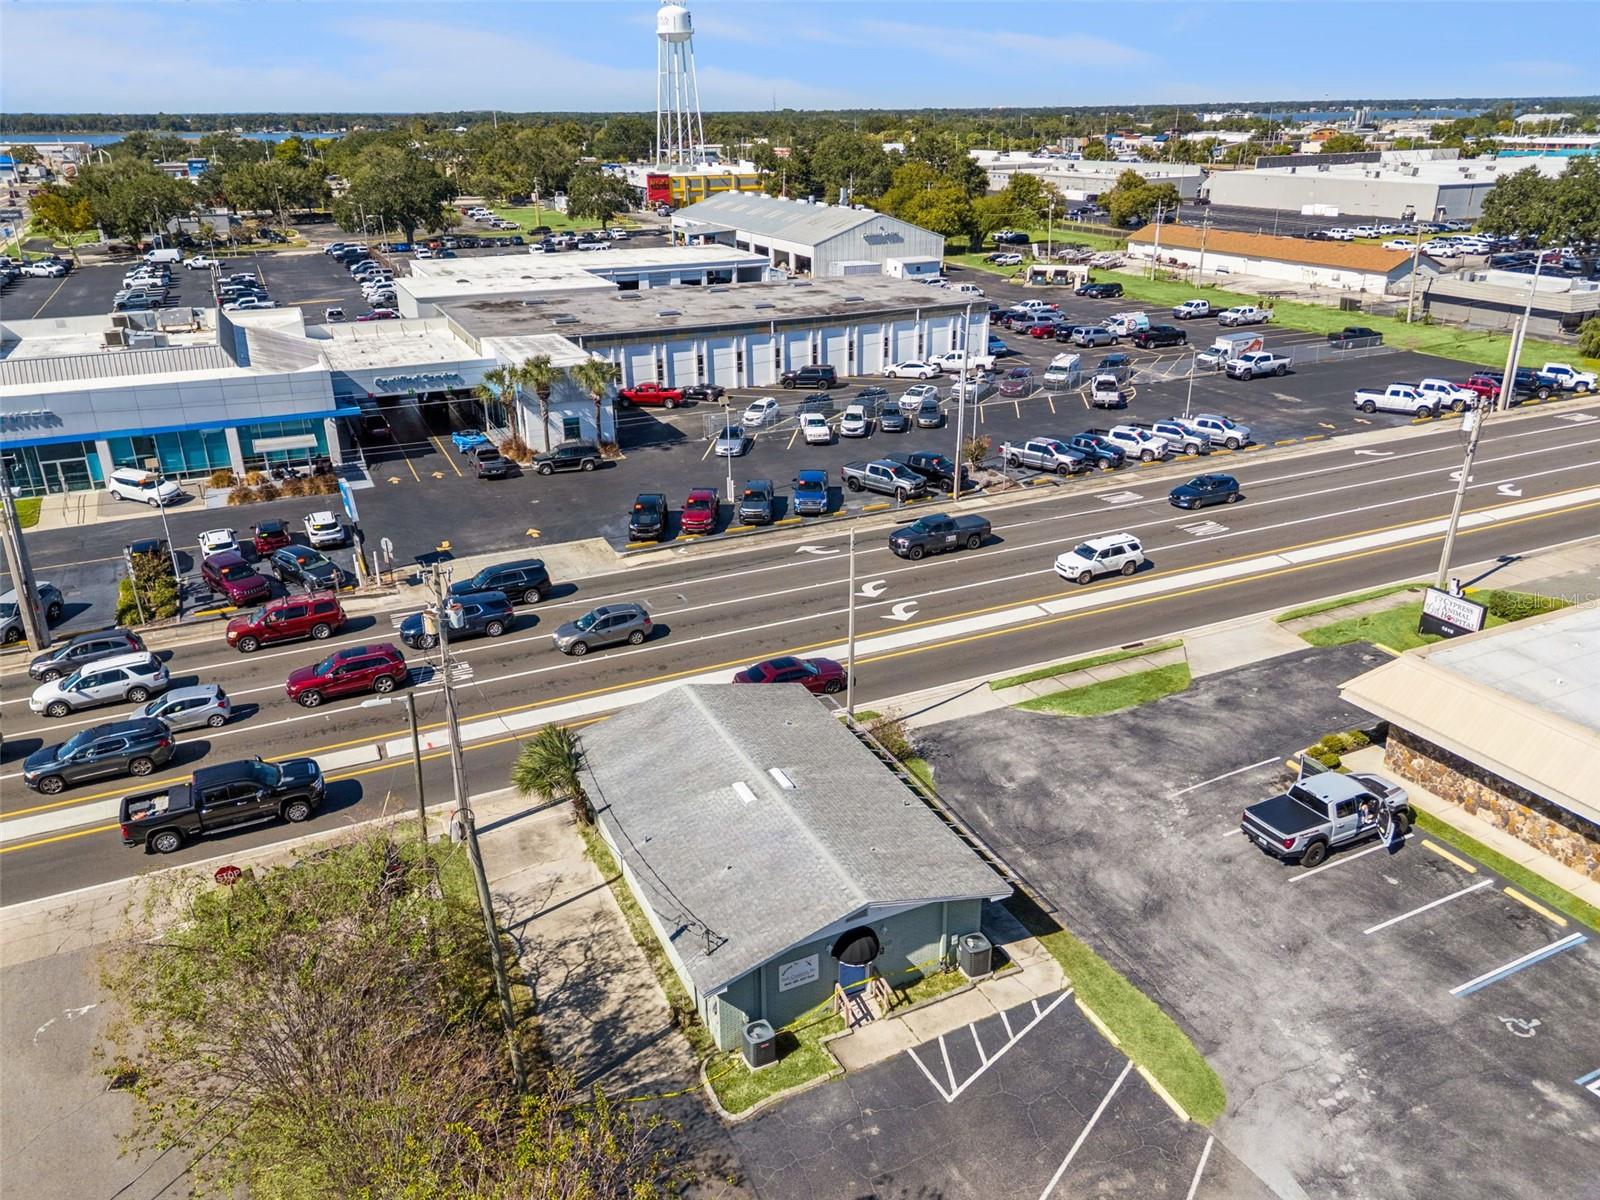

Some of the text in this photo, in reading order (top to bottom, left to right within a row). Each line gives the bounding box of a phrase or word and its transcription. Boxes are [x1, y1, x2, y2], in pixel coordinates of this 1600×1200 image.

[1442, 604, 1471, 621] ANIMAL
[1443, 598, 1474, 614] CYPRESS
[216, 869, 240, 881] STOP
